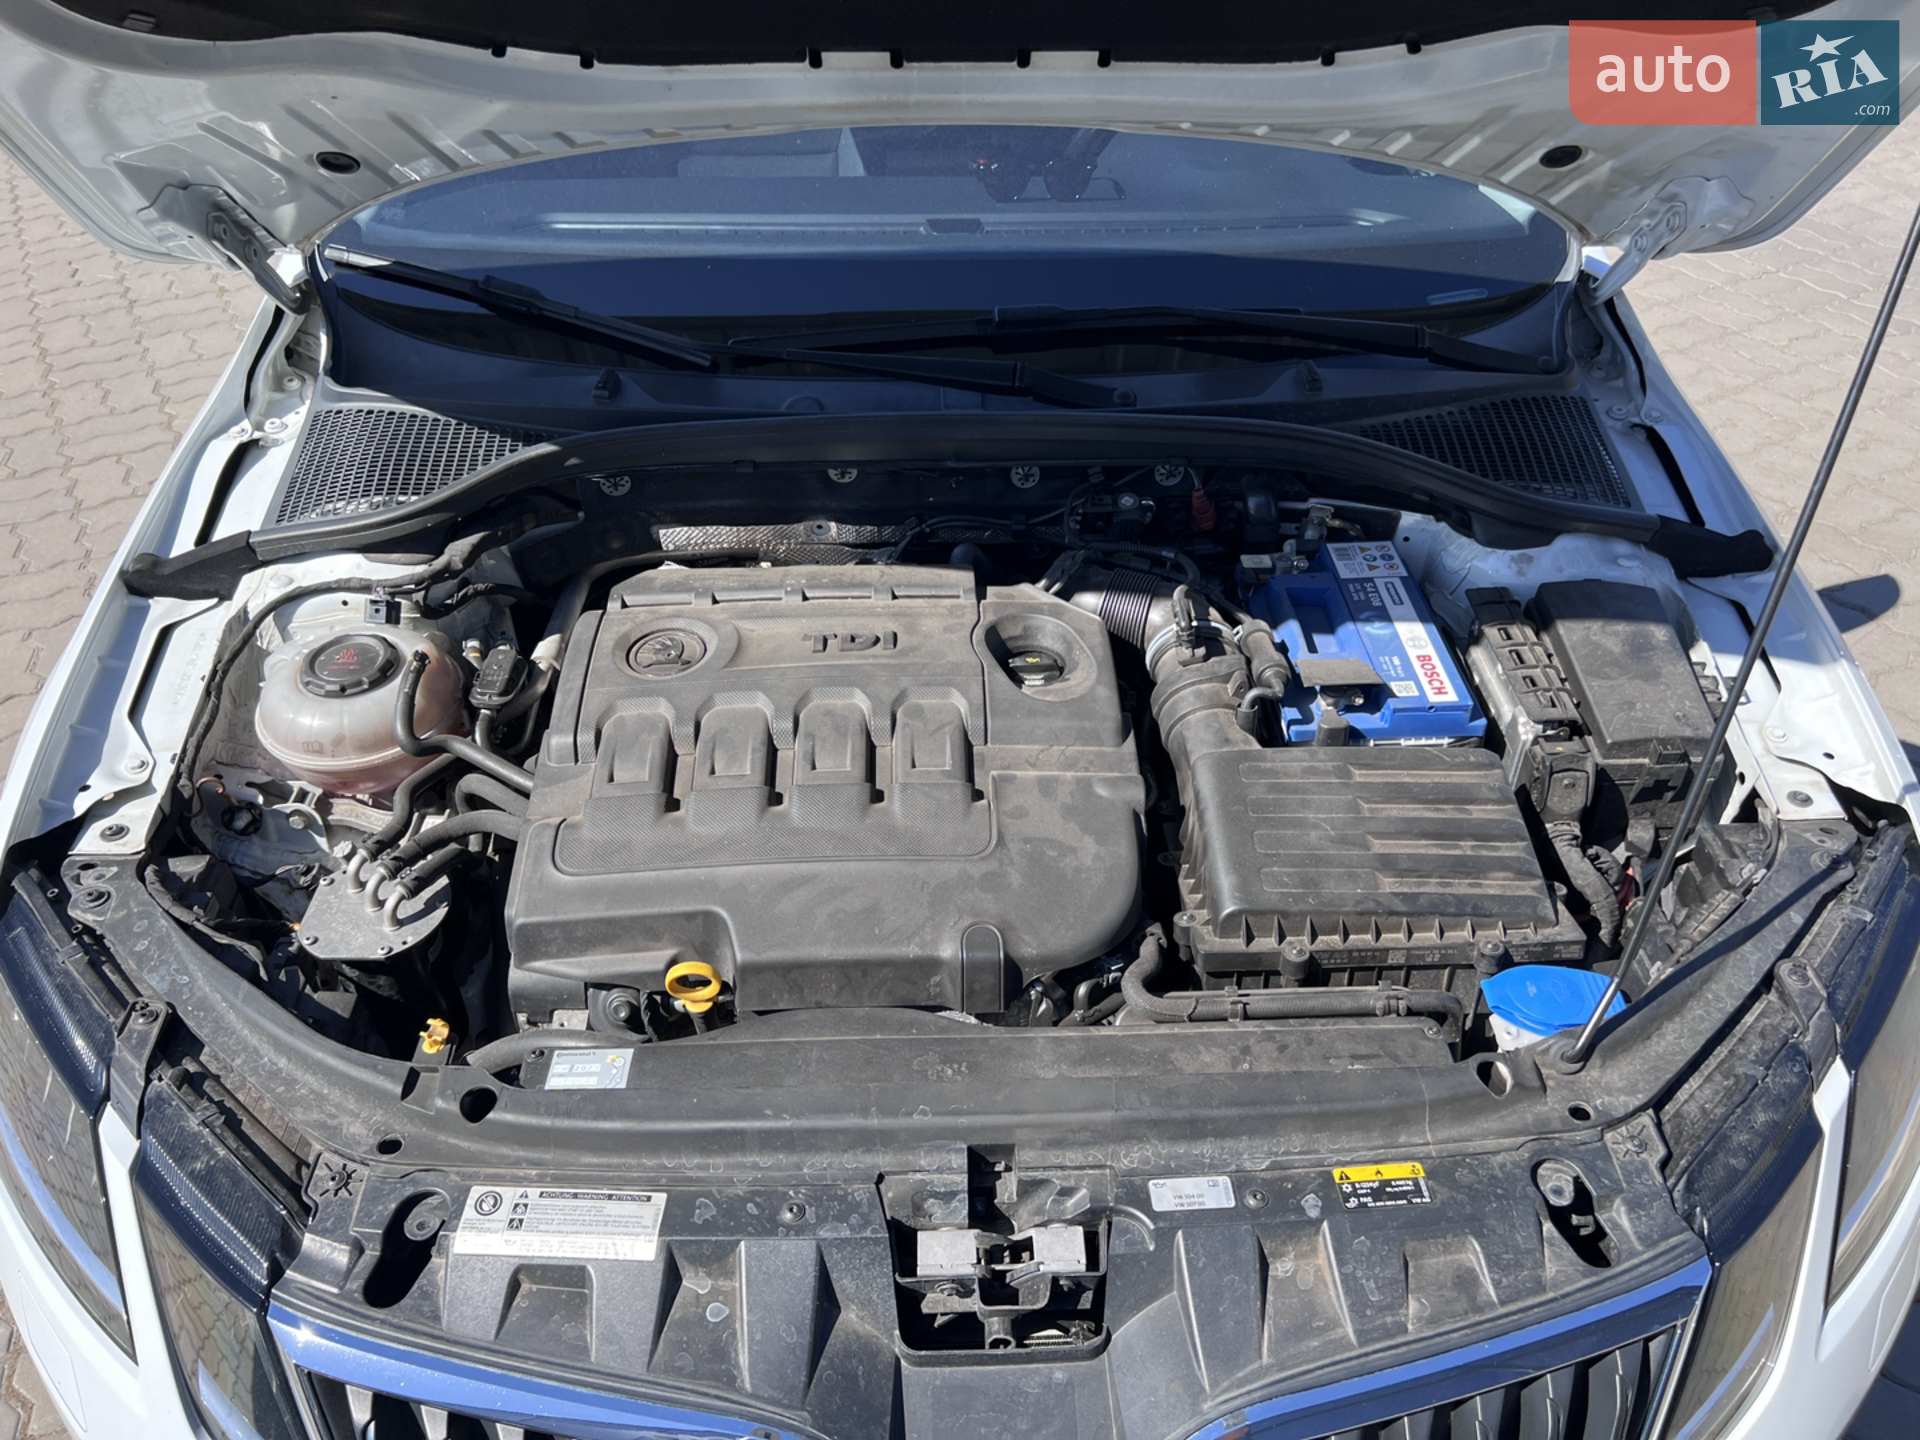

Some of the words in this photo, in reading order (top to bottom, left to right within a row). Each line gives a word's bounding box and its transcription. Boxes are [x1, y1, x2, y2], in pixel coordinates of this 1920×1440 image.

[801, 631, 898, 654] TDI
[1416, 654, 1449, 696] BOSCH
[577, 1192, 609, 1200] WARNING
[611, 1194, 648, 1202] ATTENTION
